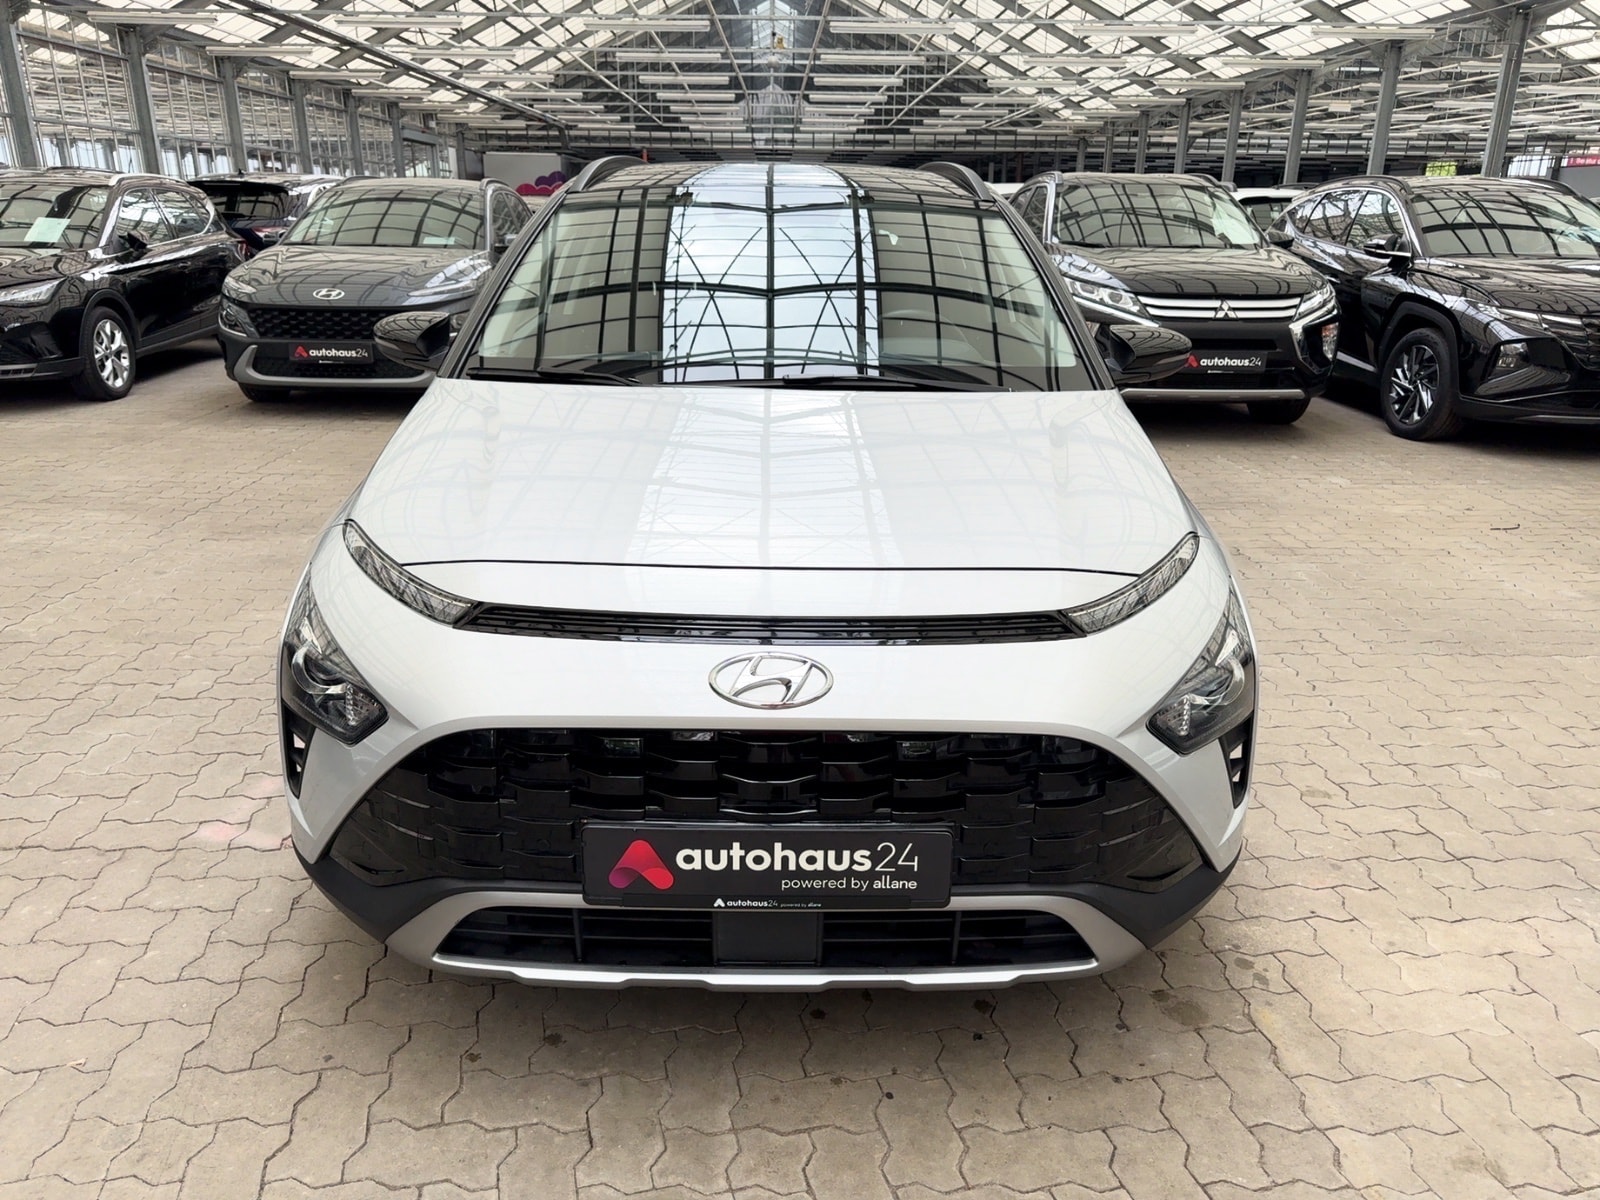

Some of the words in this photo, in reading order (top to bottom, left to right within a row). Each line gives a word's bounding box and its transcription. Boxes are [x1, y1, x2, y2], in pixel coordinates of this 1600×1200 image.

[308, 348, 368, 358] autohaus24
[1199, 356, 1262, 367] autohaus24
[675, 841, 919, 873] autohaus24
[781, 876, 846, 891] powered
[851, 876, 870, 891] by
[872, 875, 918, 890] allane
[726, 898, 778, 908] autohaus24
